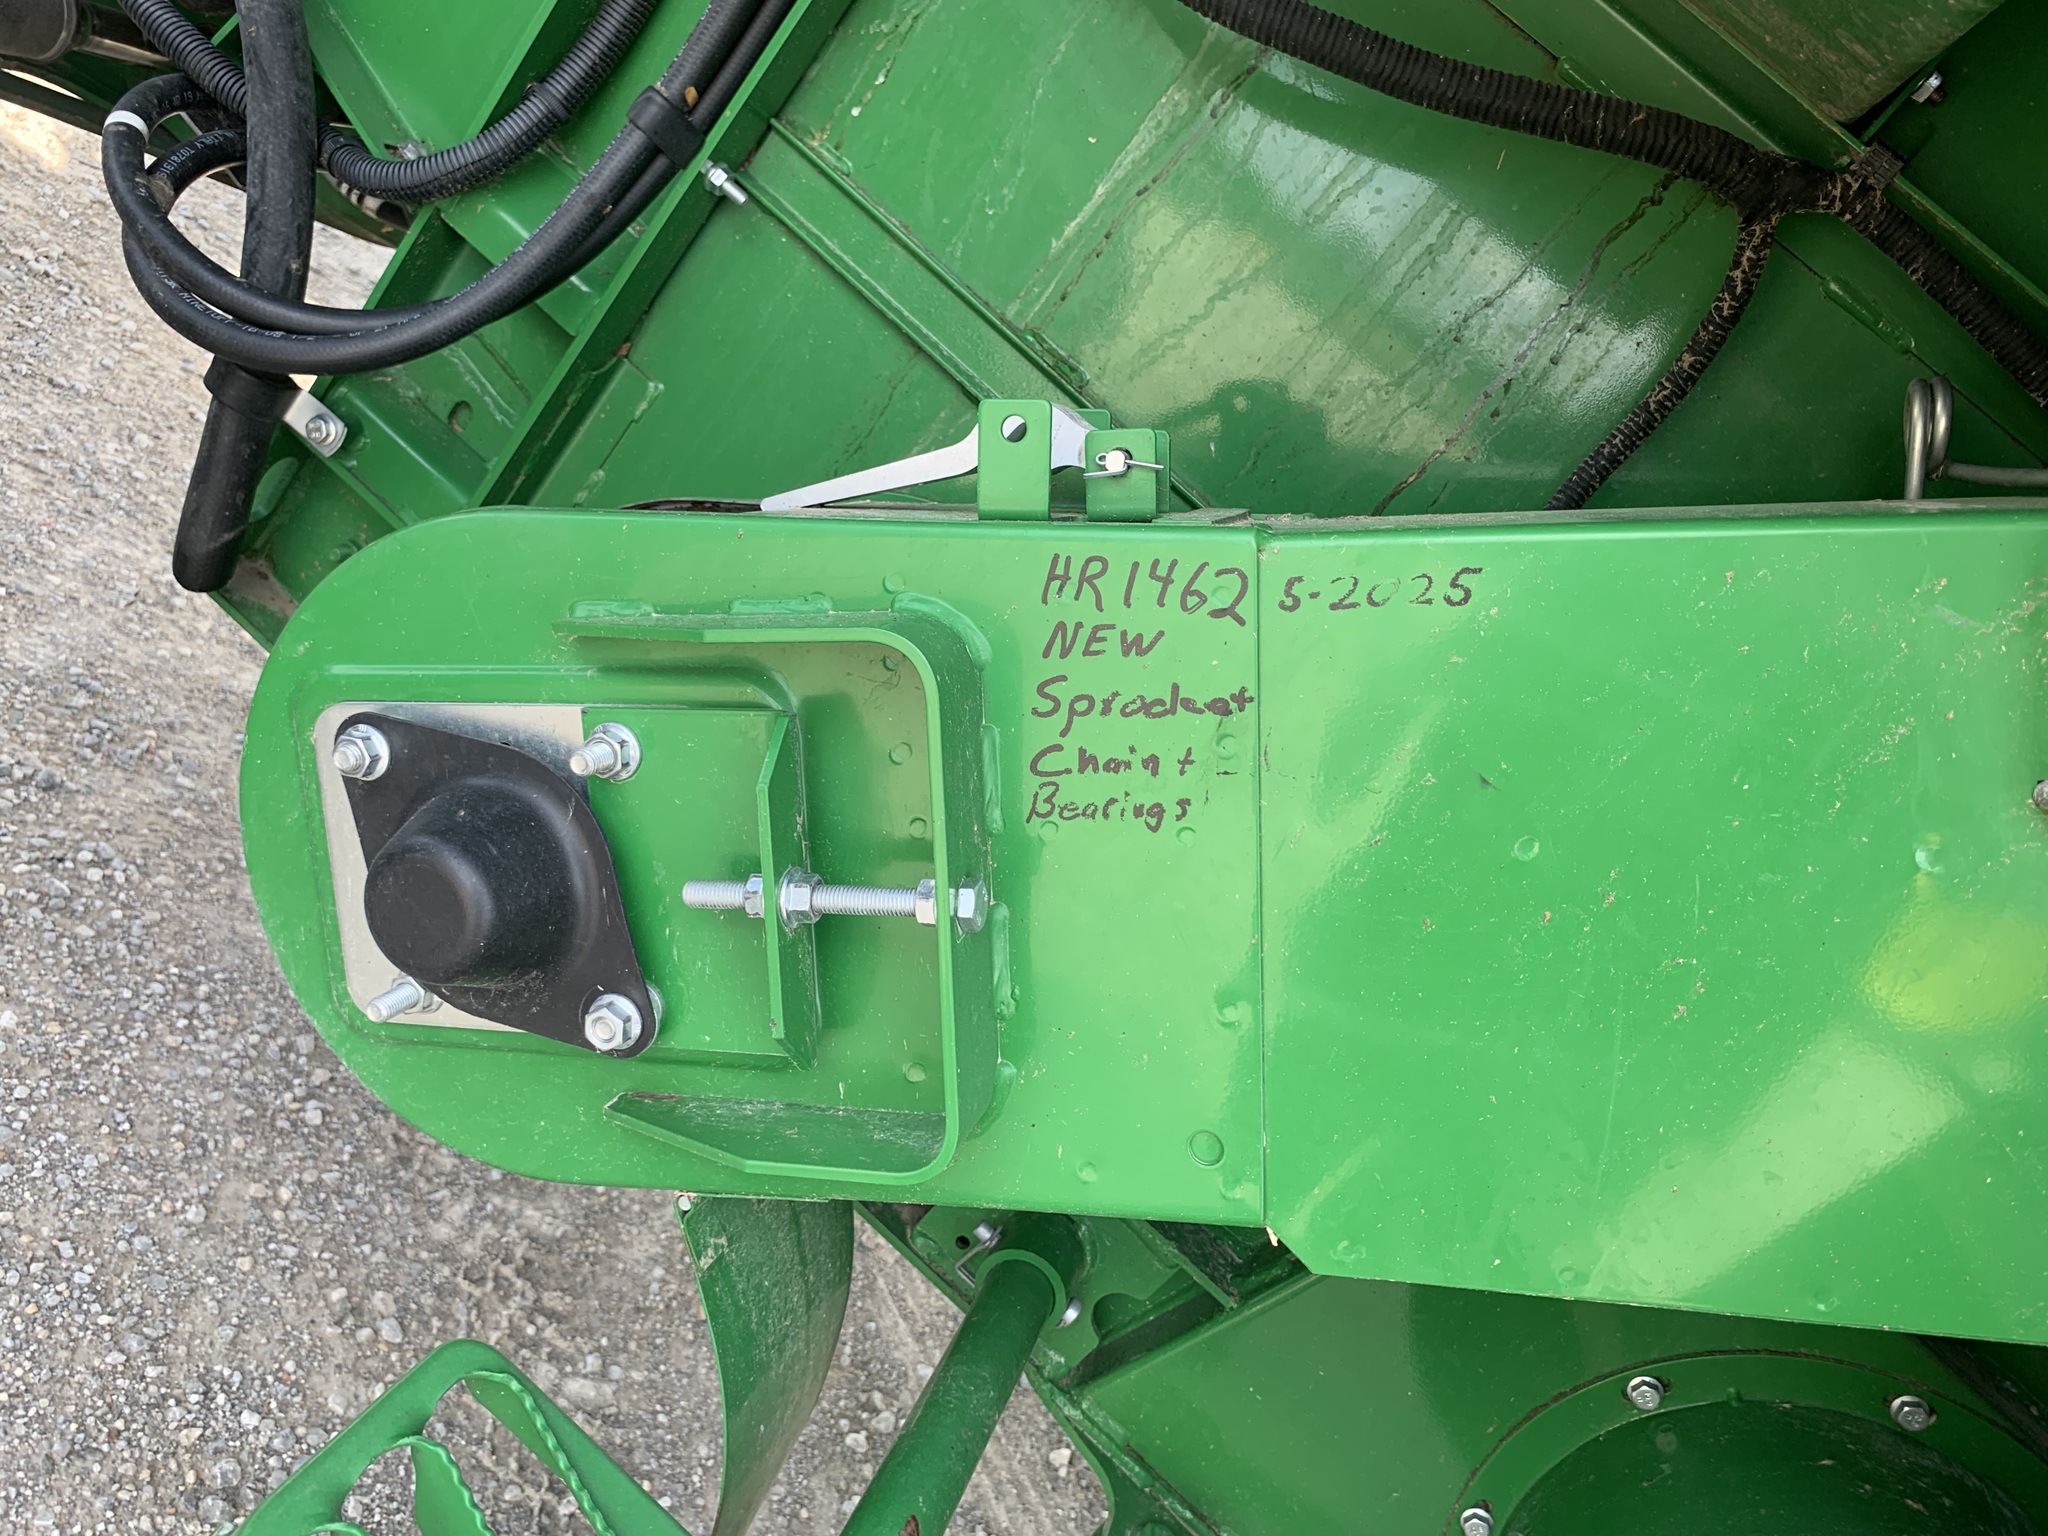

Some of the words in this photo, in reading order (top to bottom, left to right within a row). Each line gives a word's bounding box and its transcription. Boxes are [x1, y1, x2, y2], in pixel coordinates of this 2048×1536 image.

[194, 133, 225, 150] ITALY
[1041, 620, 1166, 660] NEW
[1029, 743, 1161, 778] Chain
[1025, 780, 1192, 834] Bearings
